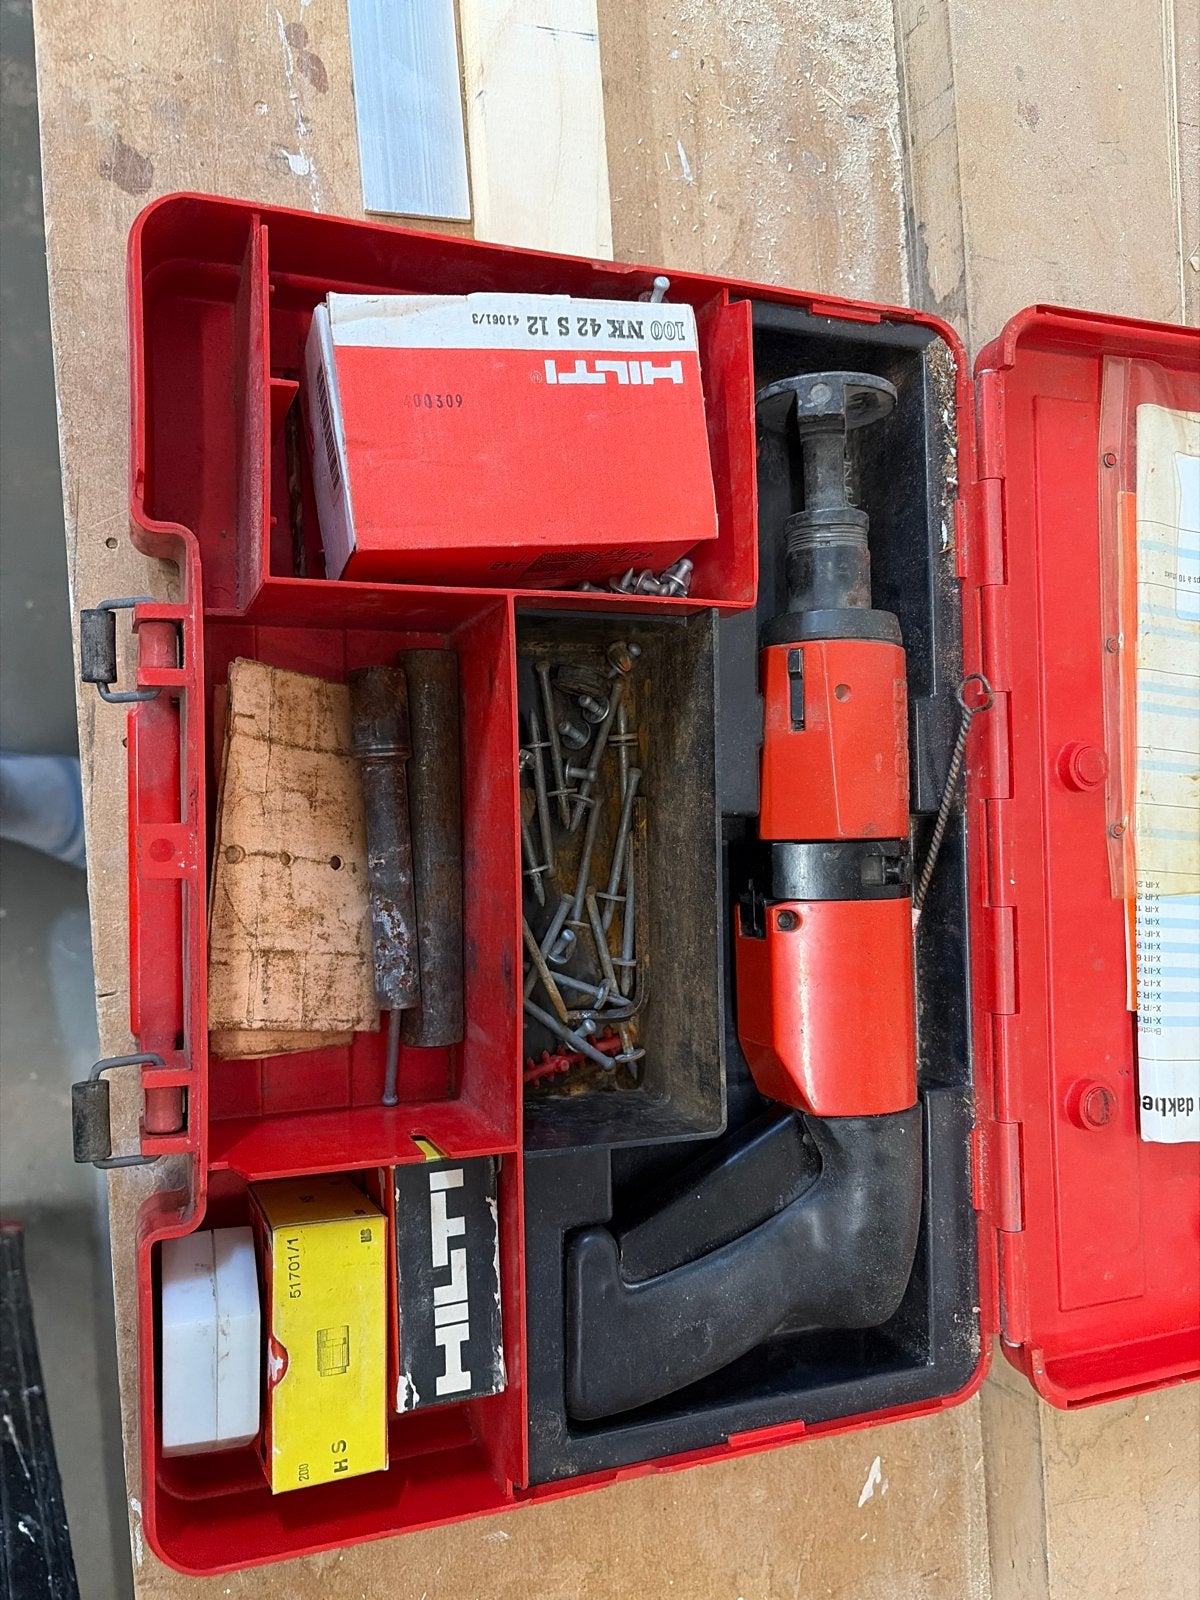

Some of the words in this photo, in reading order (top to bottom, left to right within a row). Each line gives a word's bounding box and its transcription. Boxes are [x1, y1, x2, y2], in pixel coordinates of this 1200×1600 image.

[471, 313, 520, 326] 41061/3
[527, 316, 549, 336] 12
[557, 317, 570, 337] S
[576, 317, 601, 337] 42
[606, 319, 644, 340] NK
[650, 321, 685, 340] 100
[544, 359, 684, 385] HILTI
[1145, 905, 1159, 913] X-IR
[1143, 992, 1161, 1000] X-IR
[1143, 1016, 1161, 1024] X-IR
[287, 1238, 302, 1299] 51701/1
[429, 1168, 472, 1397] HILTI
[298, 1463, 309, 1481] 200
